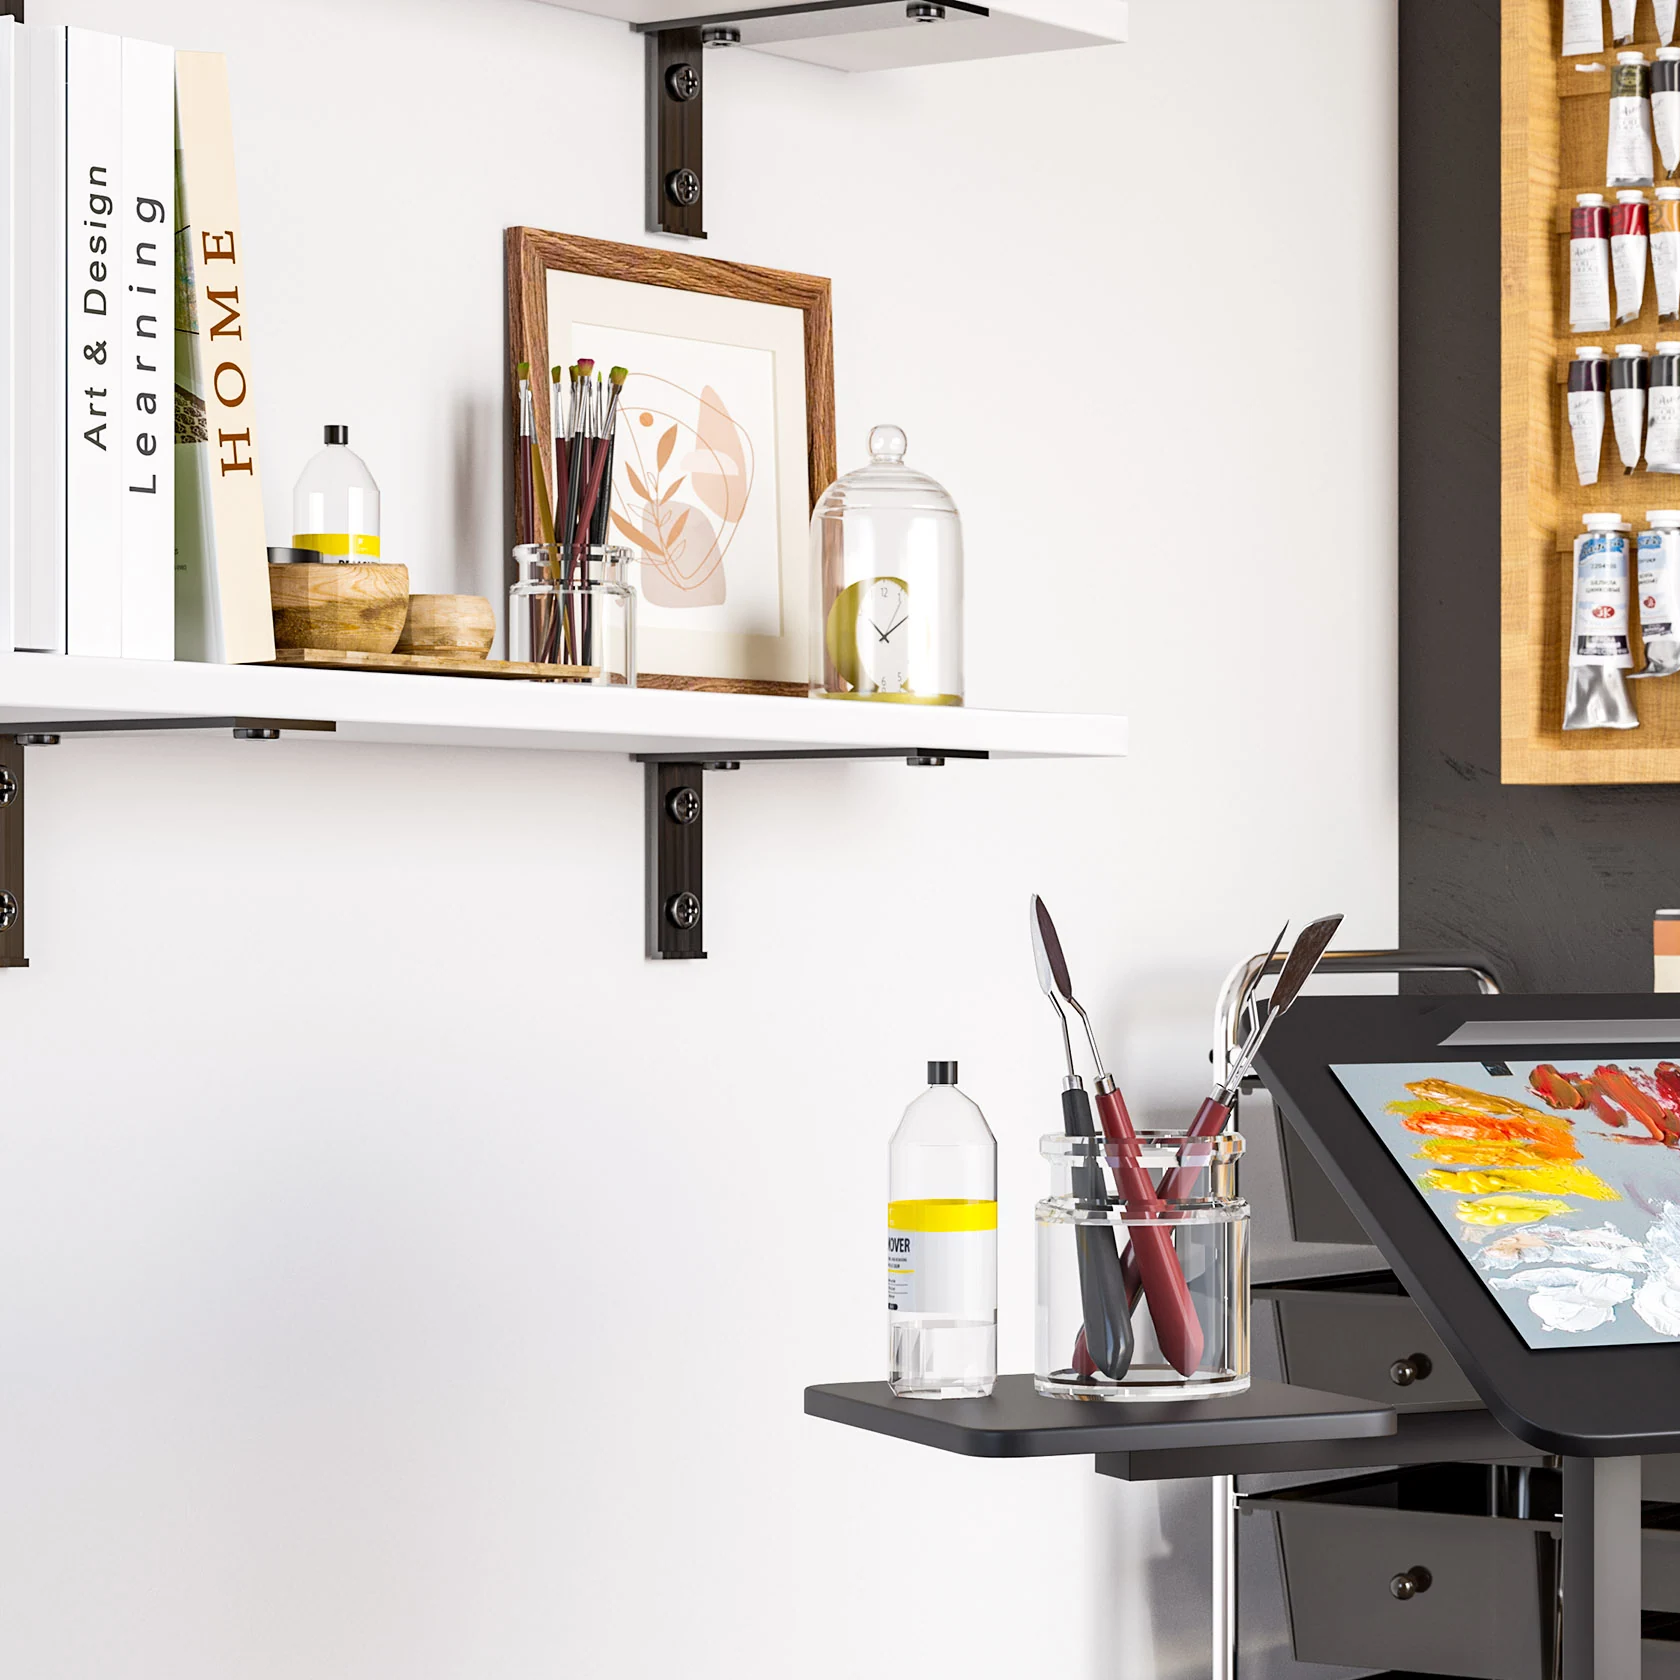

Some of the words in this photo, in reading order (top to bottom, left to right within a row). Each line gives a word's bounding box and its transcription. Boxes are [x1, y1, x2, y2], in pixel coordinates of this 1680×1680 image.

[84, 166, 113, 315] Design
[84, 341, 106, 365] &
[84, 387, 106, 451] Art
[129, 197, 165, 494] Learning
[202, 231, 253, 476] HOME
